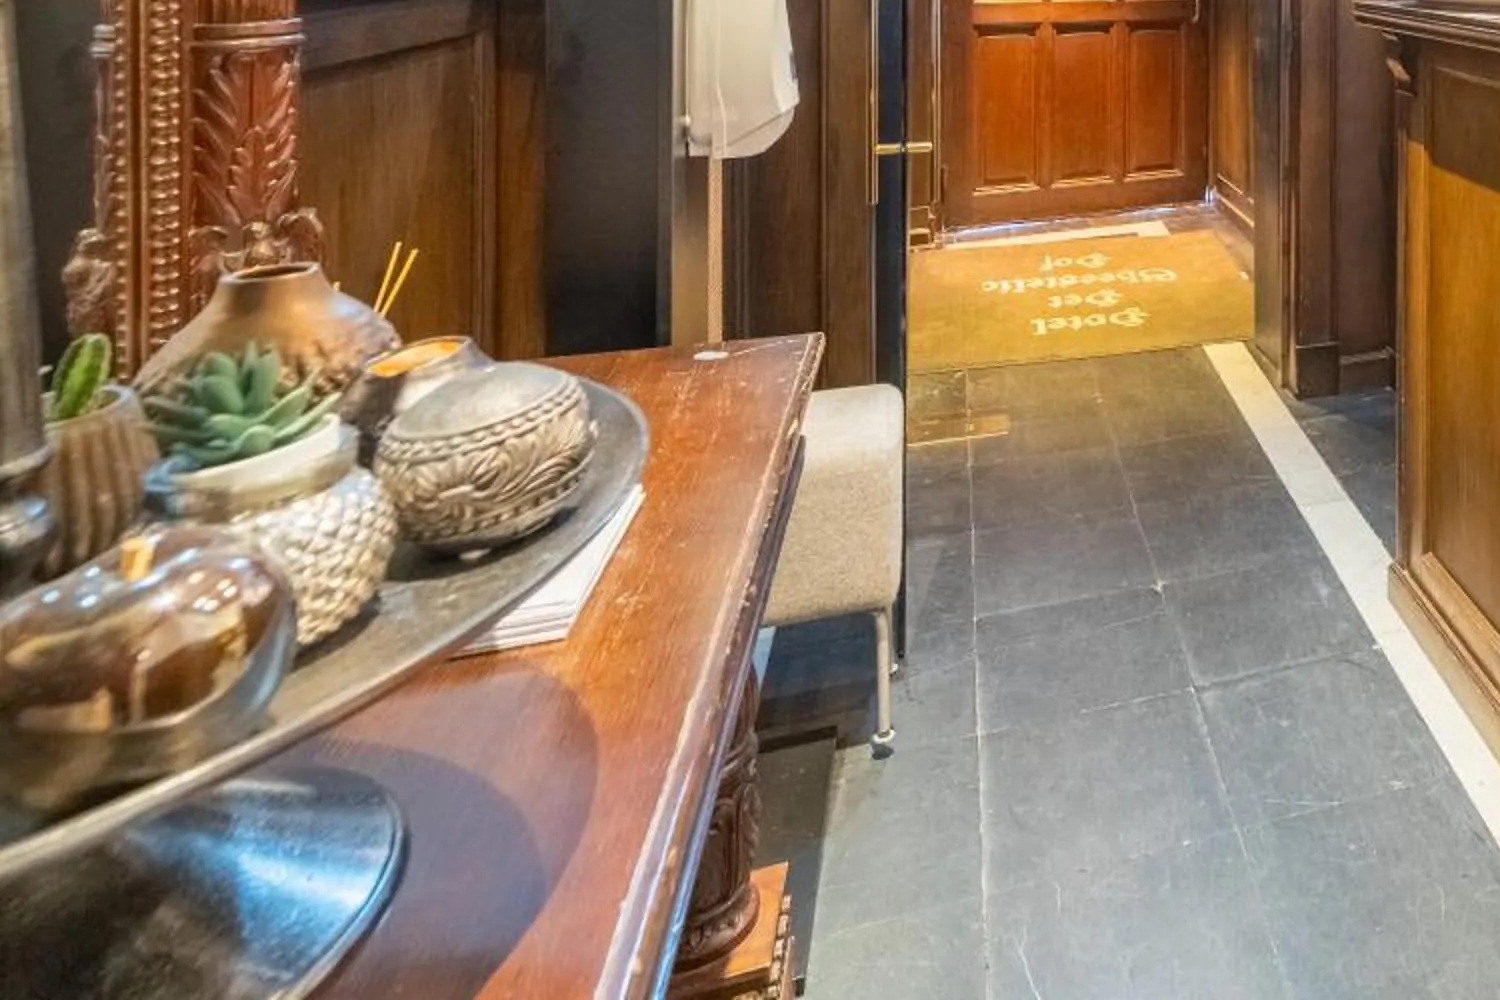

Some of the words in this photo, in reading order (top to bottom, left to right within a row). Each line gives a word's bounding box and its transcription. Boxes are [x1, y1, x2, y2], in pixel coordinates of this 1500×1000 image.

[1039, 251, 1113, 273] Hof
[1047, 289, 1123, 309] Het
[1030, 306, 1149, 336] Hotel
